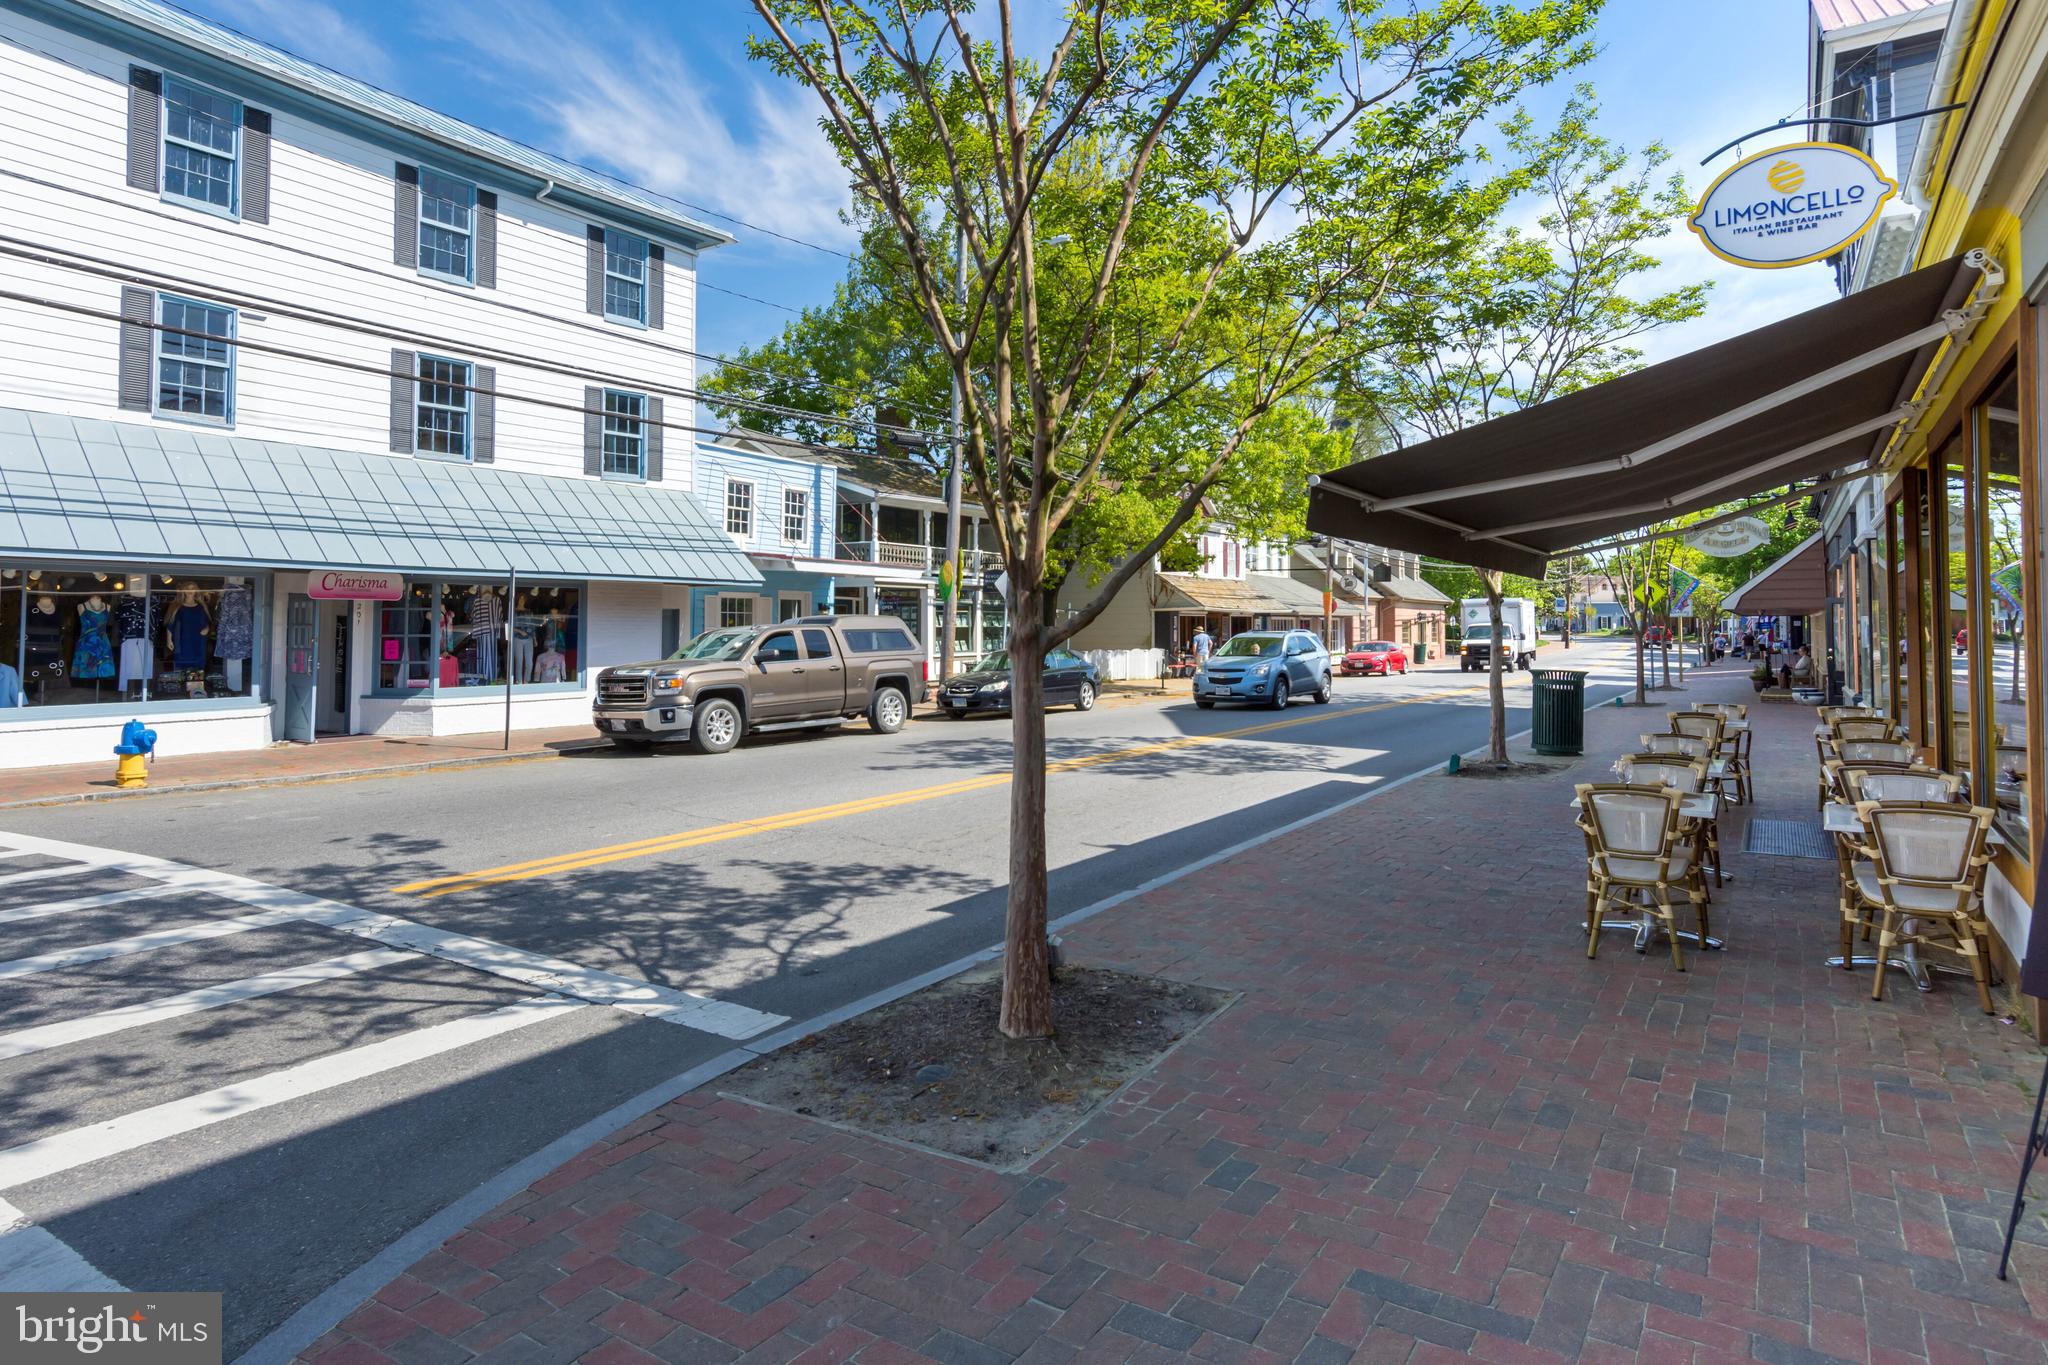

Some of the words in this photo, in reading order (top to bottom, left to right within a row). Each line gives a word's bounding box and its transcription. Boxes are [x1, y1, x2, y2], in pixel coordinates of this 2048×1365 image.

[1714, 185, 1865, 228] LIMONCELLO
[1732, 223, 1772, 235] ITALIAN
[1775, 211, 1844, 228] RESTAURANT
[1757, 230, 1764, 238] &
[1767, 225, 1794, 236] WINE
[1797, 222, 1818, 232] BAR
[322, 572, 388, 591] Charisma
